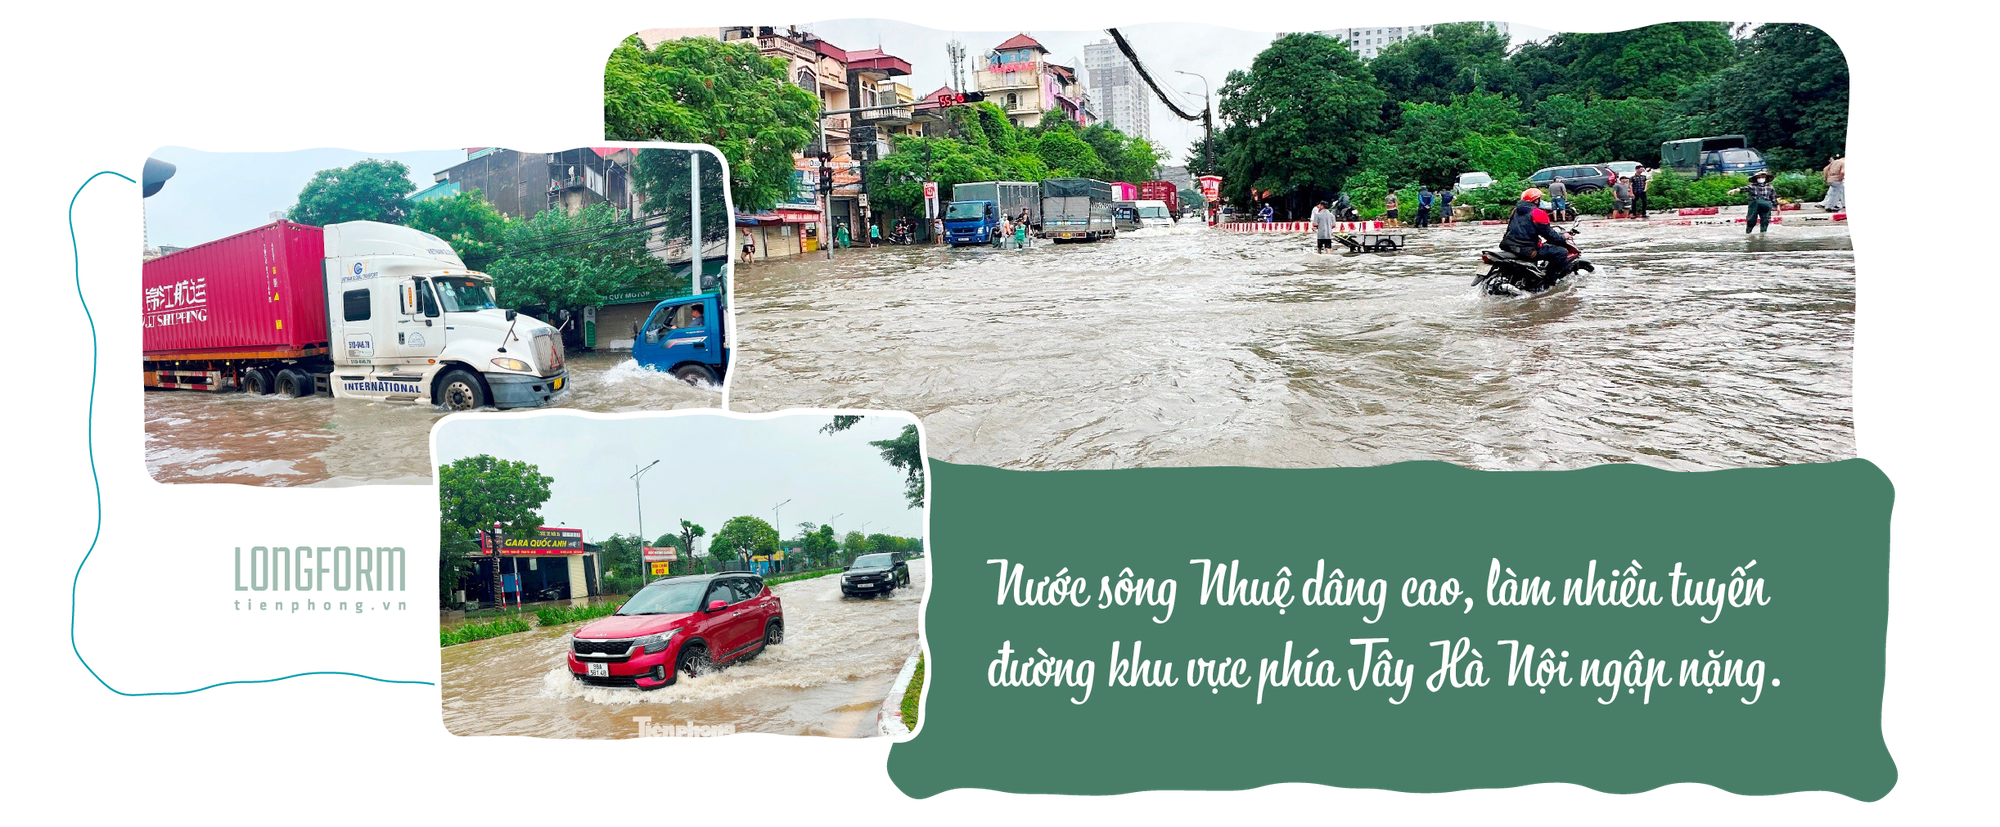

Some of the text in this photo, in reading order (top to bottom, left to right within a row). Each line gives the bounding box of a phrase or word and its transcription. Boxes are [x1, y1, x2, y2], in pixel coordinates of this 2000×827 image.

[158, 308, 208, 327] SHIPPING
[344, 381, 422, 394] INTERNATIONAL
[505, 537, 567, 548] GARA QUỐC ANH
